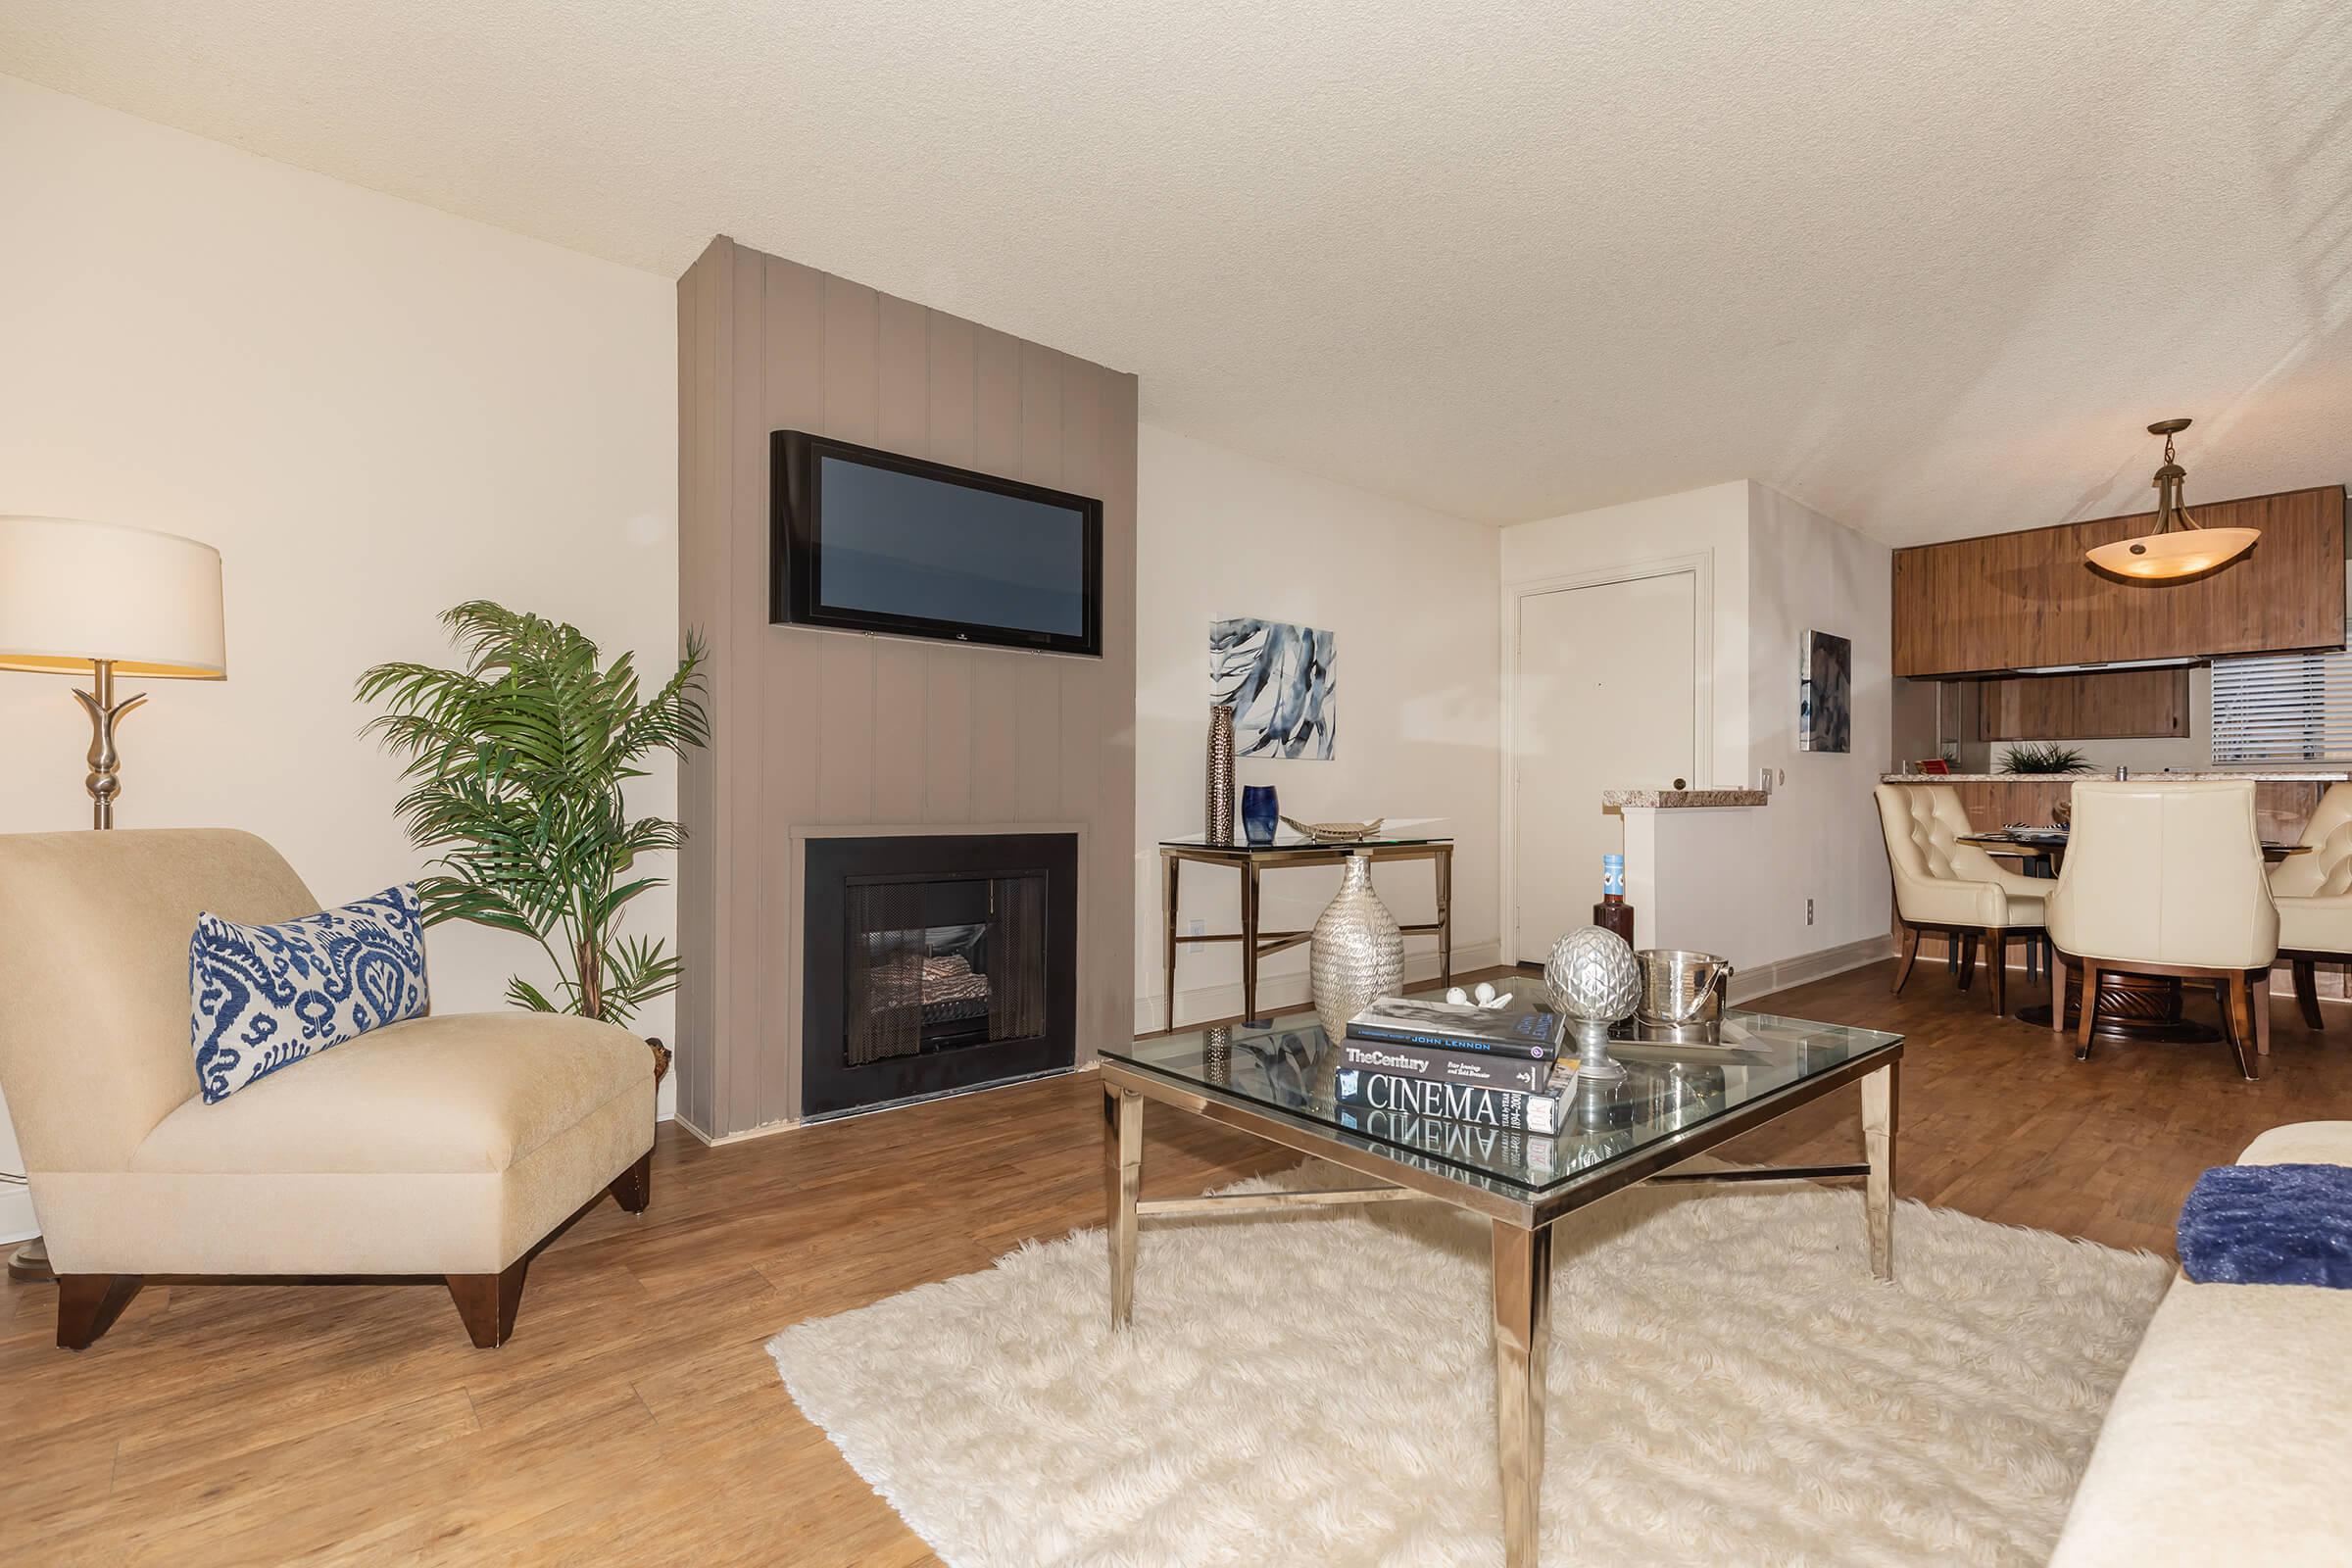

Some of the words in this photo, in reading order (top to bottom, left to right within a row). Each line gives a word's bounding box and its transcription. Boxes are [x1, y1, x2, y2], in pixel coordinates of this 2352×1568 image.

[1411, 1036, 1441, 1045] JOHN
[1445, 1040, 1491, 1051] LENNON
[1346, 1048, 1429, 1073] TheCentury
[1366, 1074, 1499, 1126] CINEMA
